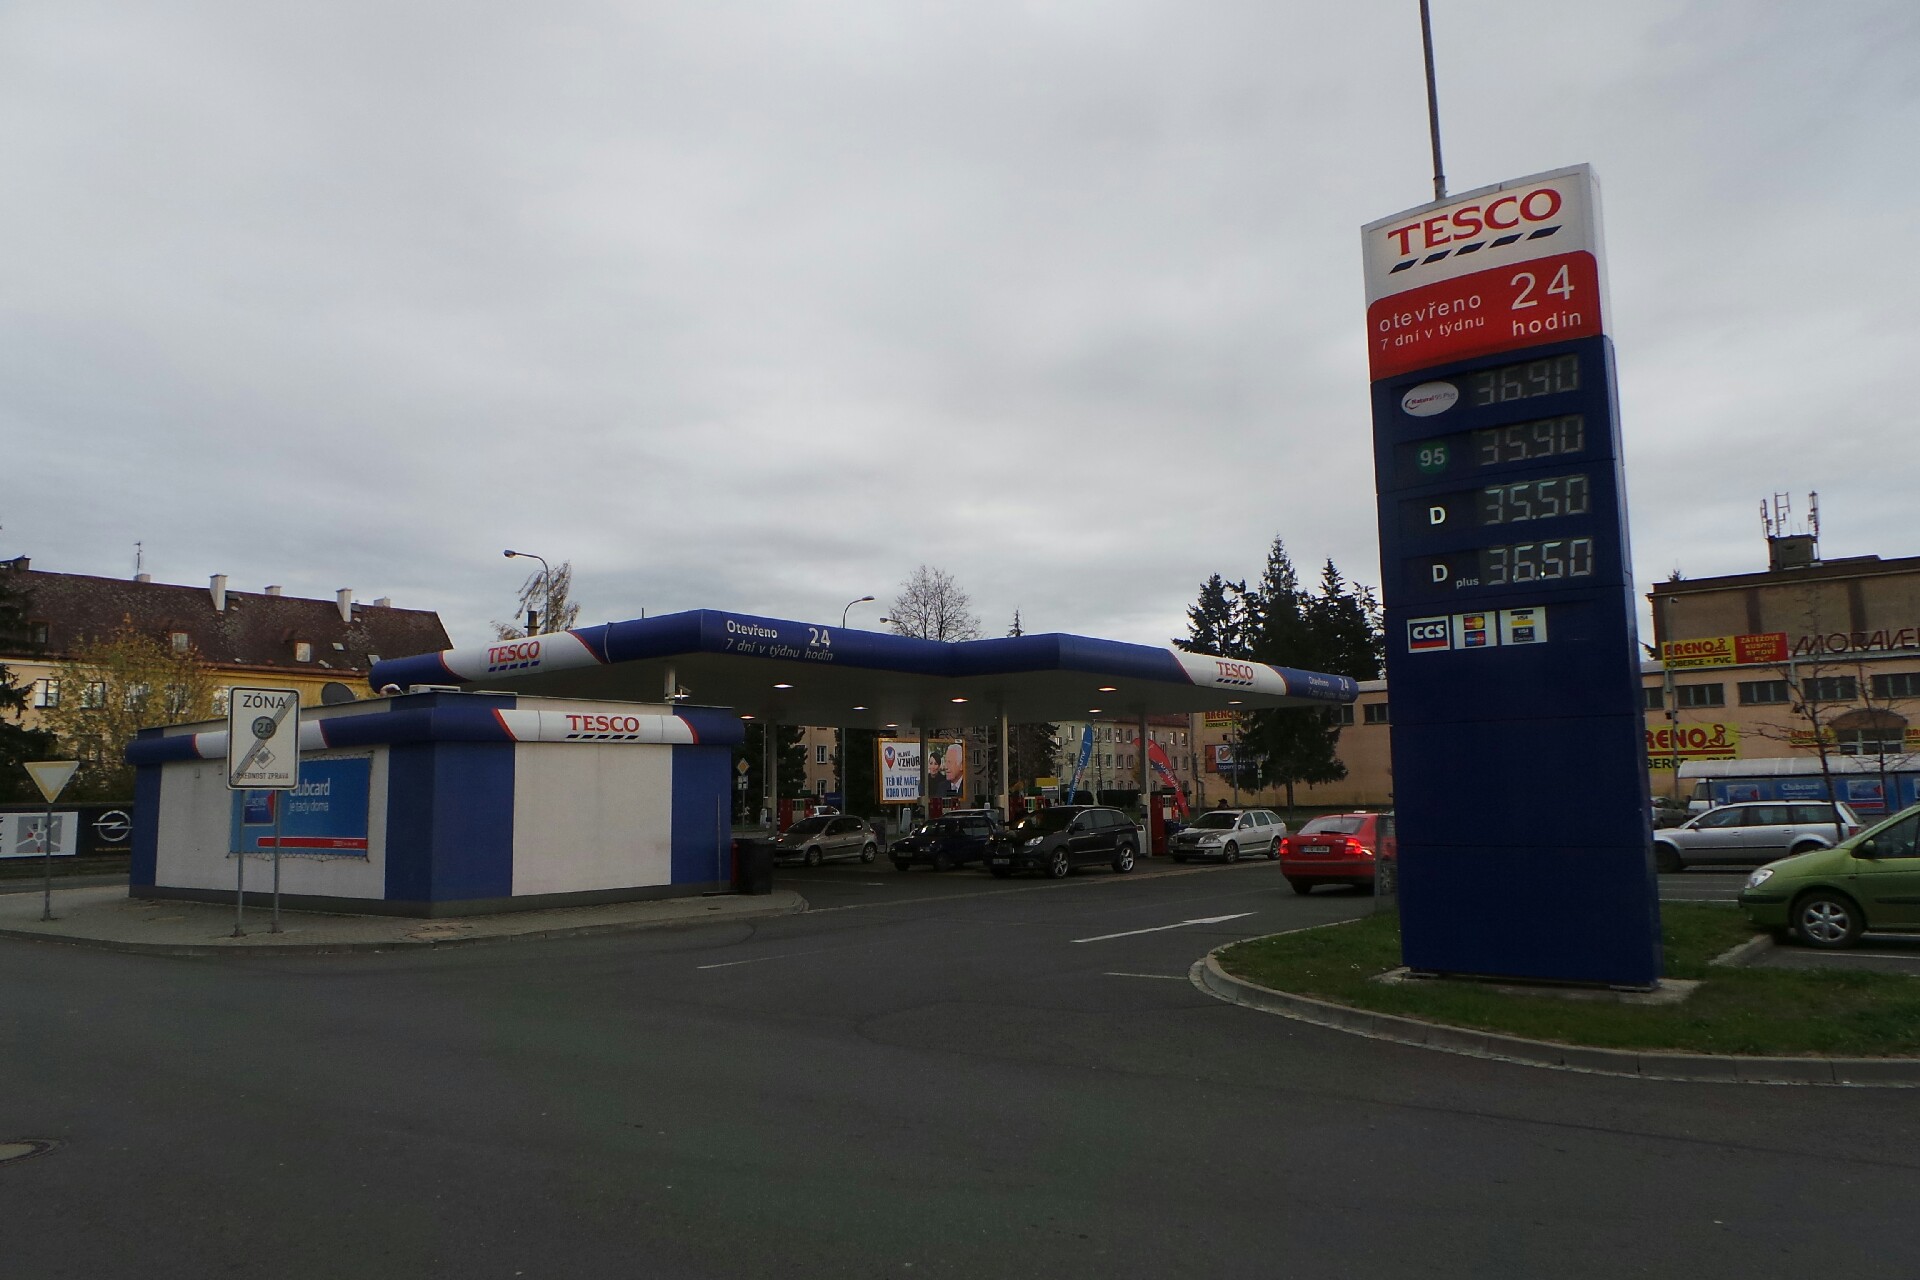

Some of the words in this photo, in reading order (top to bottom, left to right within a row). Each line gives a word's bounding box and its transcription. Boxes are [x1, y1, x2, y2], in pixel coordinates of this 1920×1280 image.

[1387, 188, 1562, 256] TESCO
[1510, 264, 1576, 310] 24
[1380, 295, 1481, 332] otevřeno
[1513, 311, 1581, 336] hodin
[1381, 338, 1388, 351] 7
[1395, 330, 1419, 347] dní
[1425, 329, 1433, 339] v
[1440, 317, 1484, 337] týdnu
[1478, 355, 1578, 406] 36.90
[1419, 447, 1446, 467] 95
[1484, 476, 1588, 526] 35.50
[1429, 506, 1446, 525] D
[1487, 538, 1592, 586] 36.50
[1432, 564, 1448, 583] D
[1455, 576, 1479, 590] plus
[726, 620, 778, 639] Otevřeno
[808, 627, 831, 648] 24
[1412, 624, 1445, 640] CCS
[488, 641, 540, 663] TESCO
[725, 638, 734, 649] 7
[737, 640, 757, 653] dní
[759, 645, 766, 654] v
[769, 645, 800, 658] týdnu
[804, 647, 834, 661] hodin
[1664, 641, 1714, 656] BRENO
[1792, 628, 1920, 657] MORAVE
[1216, 661, 1254, 680] TESCO
[1665, 658, 1705, 668] KOBERCE
[1713, 657, 1731, 665] PVC
[1338, 677, 1350, 691] 24
[242, 692, 286, 709] ZÓNA
[566, 714, 640, 733] TESCO
[1645, 728, 1707, 749] RENO
[897, 755, 921, 768] VZHŮR
